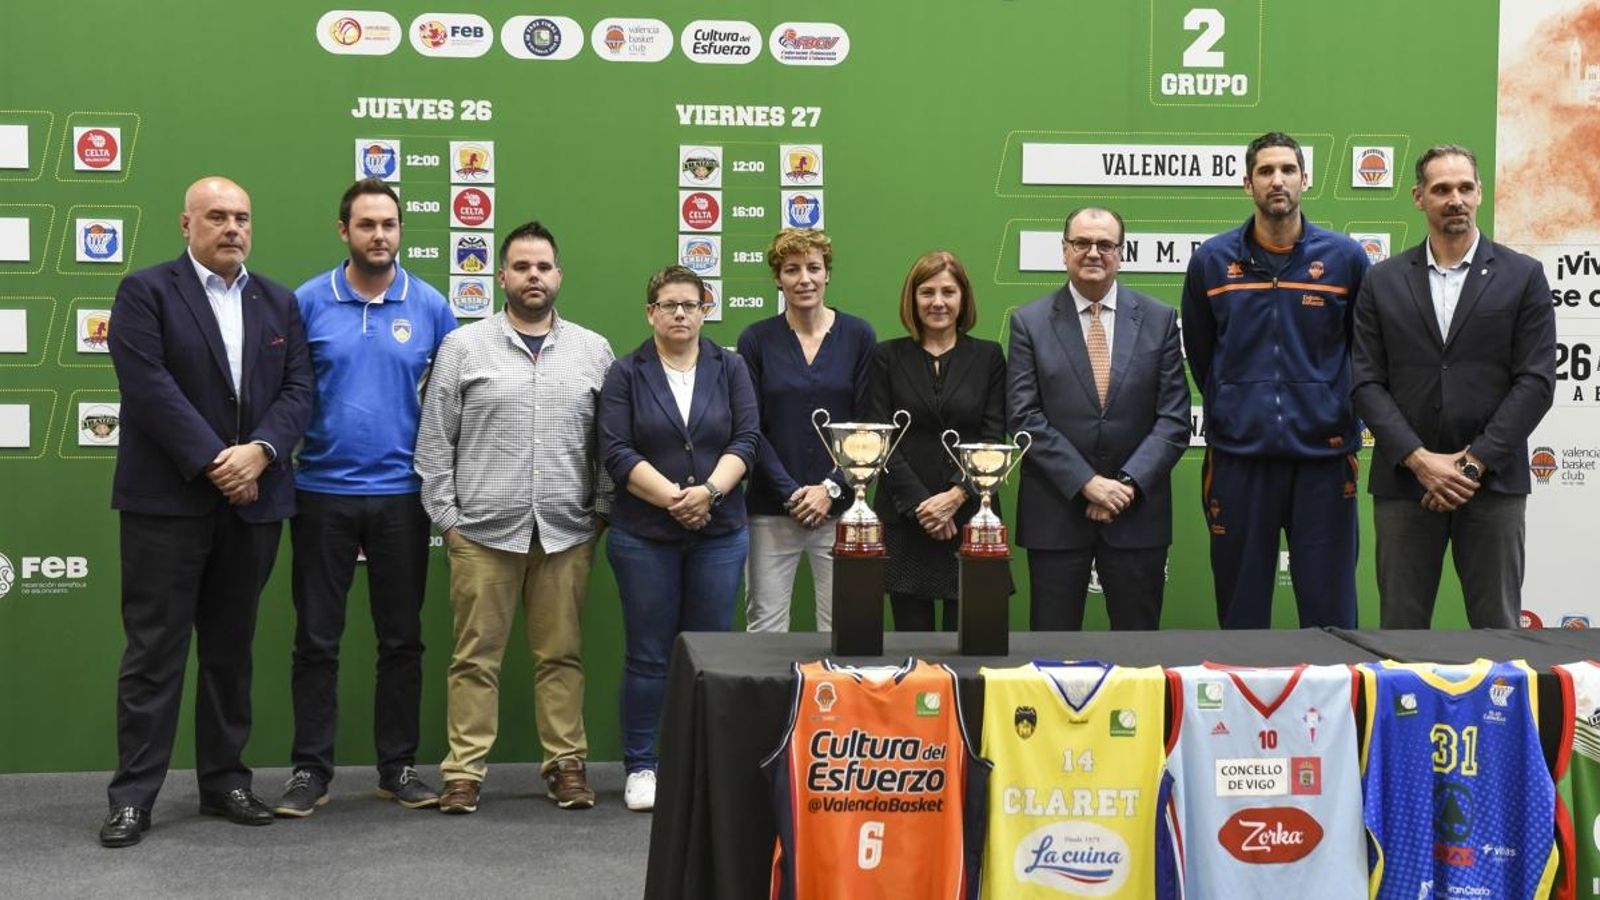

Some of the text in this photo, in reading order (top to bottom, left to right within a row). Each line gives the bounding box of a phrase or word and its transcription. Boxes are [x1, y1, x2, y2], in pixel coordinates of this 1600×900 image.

[694, 28, 739, 42] Cultura
[1183, 8, 1225, 67] 2
[628, 44, 646, 52] club
[693, 42, 751, 55] Esfuerzo
[1161, 73, 1248, 96] GRUPO
[351, 97, 492, 121] JUEVES 26
[676, 104, 822, 127] VIERNES 27
[85, 149, 110, 157] CELTA
[406, 155, 440, 166] 12:00
[733, 161, 765, 172] 12:00
[1102, 153, 1237, 178] VALENCIA BC
[406, 201, 440, 212] 16:00
[460, 207, 484, 216] CELTA
[732, 206, 765, 217] 16:00
[689, 211, 712, 220] CELTA
[408, 247, 439, 258] 18:15
[733, 252, 763, 262] 18:15
[1156, 241, 1181, 263] M.
[729, 296, 764, 308] 20:30
[1562, 446, 1600, 458] valencia
[1562, 458, 1596, 470] basket
[1562, 470, 1585, 481] club
[809, 729, 946, 761] Cultura del
[1258, 730, 1278, 749] 10
[1429, 722, 1478, 777] 31
[1062, 750, 1094, 772] 14
[807, 760, 945, 793] Esfuerzo
[1221, 764, 1283, 776] CONCELLO
[1228, 780, 1275, 790] DE VIGO
[808, 797, 944, 813] @ValenciaBasket
[1003, 786, 1140, 818] CLARET
[1239, 819, 1304, 852] Zorka
[857, 820, 885, 870] 6
[1025, 835, 1122, 873] La cuina
